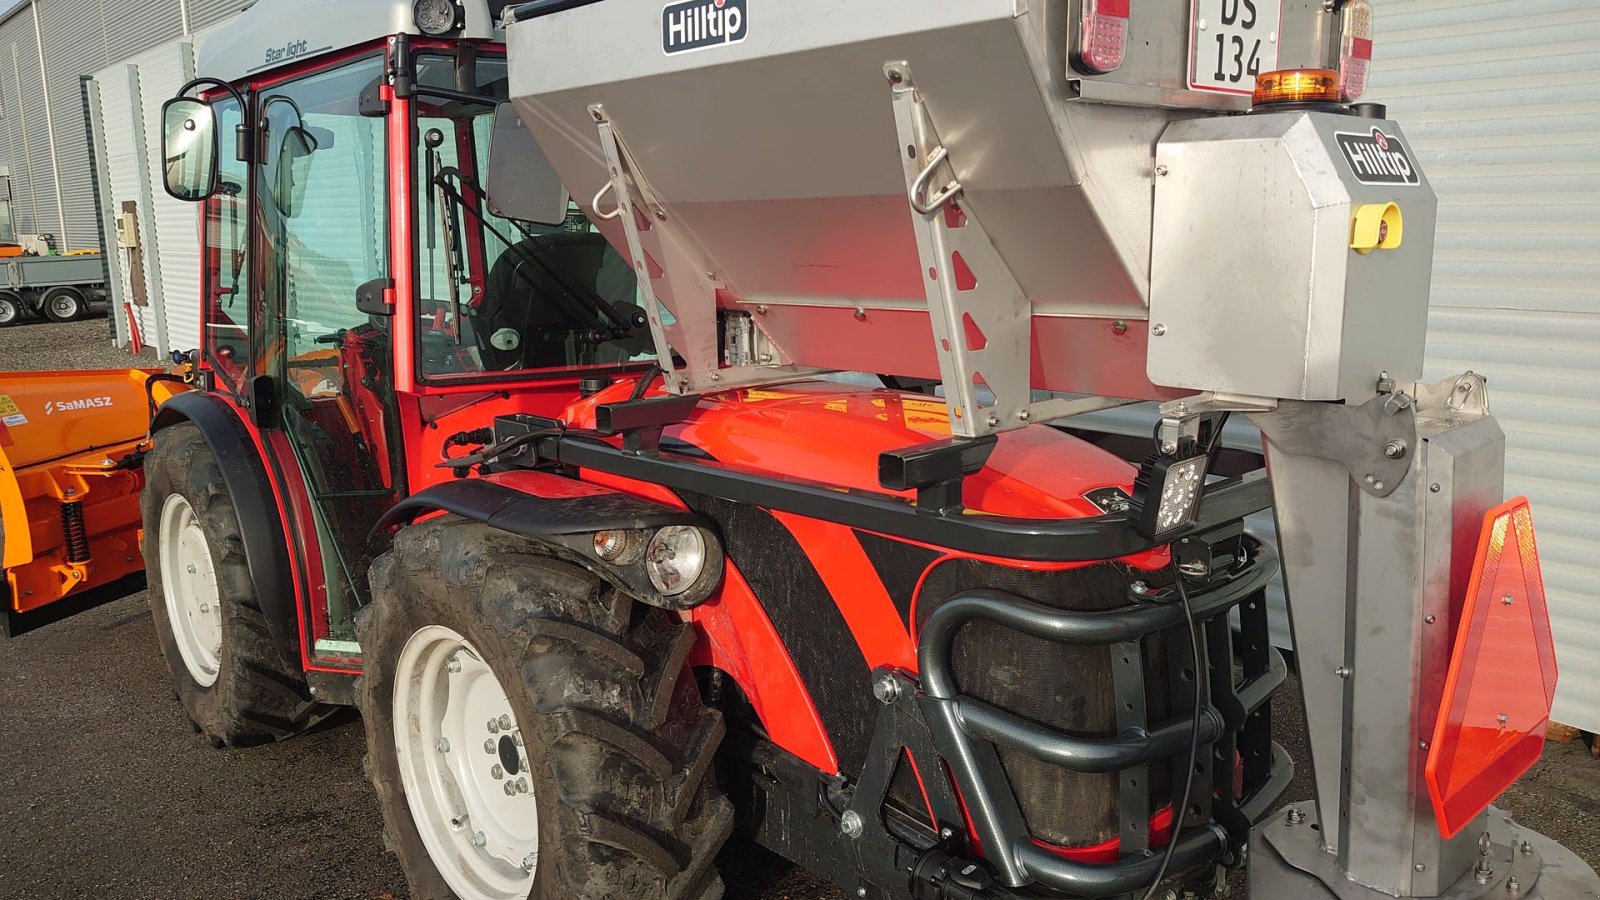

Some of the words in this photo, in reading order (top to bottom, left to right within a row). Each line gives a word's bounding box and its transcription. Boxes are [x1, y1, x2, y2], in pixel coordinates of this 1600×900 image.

[668, 3, 742, 47] Hilltip
[265, 47, 286, 63] Star
[286, 40, 307, 59] light
[1214, 33, 1261, 83] 134
[1343, 141, 1411, 184] Hilltip
[56, 396, 113, 412] SaMASZ
